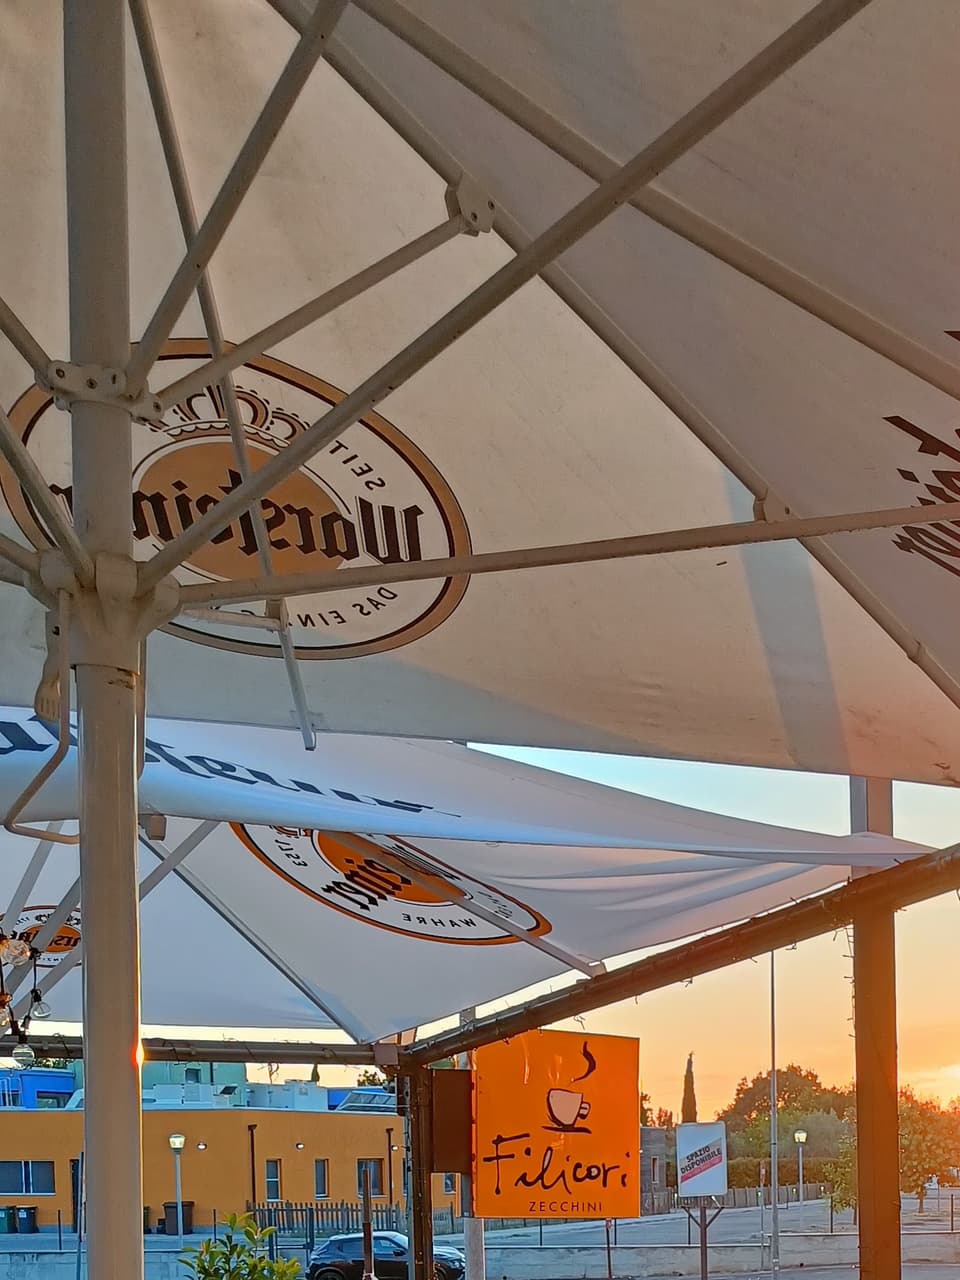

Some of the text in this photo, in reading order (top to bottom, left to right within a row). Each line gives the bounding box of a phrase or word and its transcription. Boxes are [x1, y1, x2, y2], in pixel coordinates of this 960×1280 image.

[483, 1134, 631, 1195] Filicori
[680, 1147, 722, 1174] DISPONIBILE
[686, 1145, 711, 1163] SPAZIO
[529, 1201, 603, 1213] ZECCHINI
